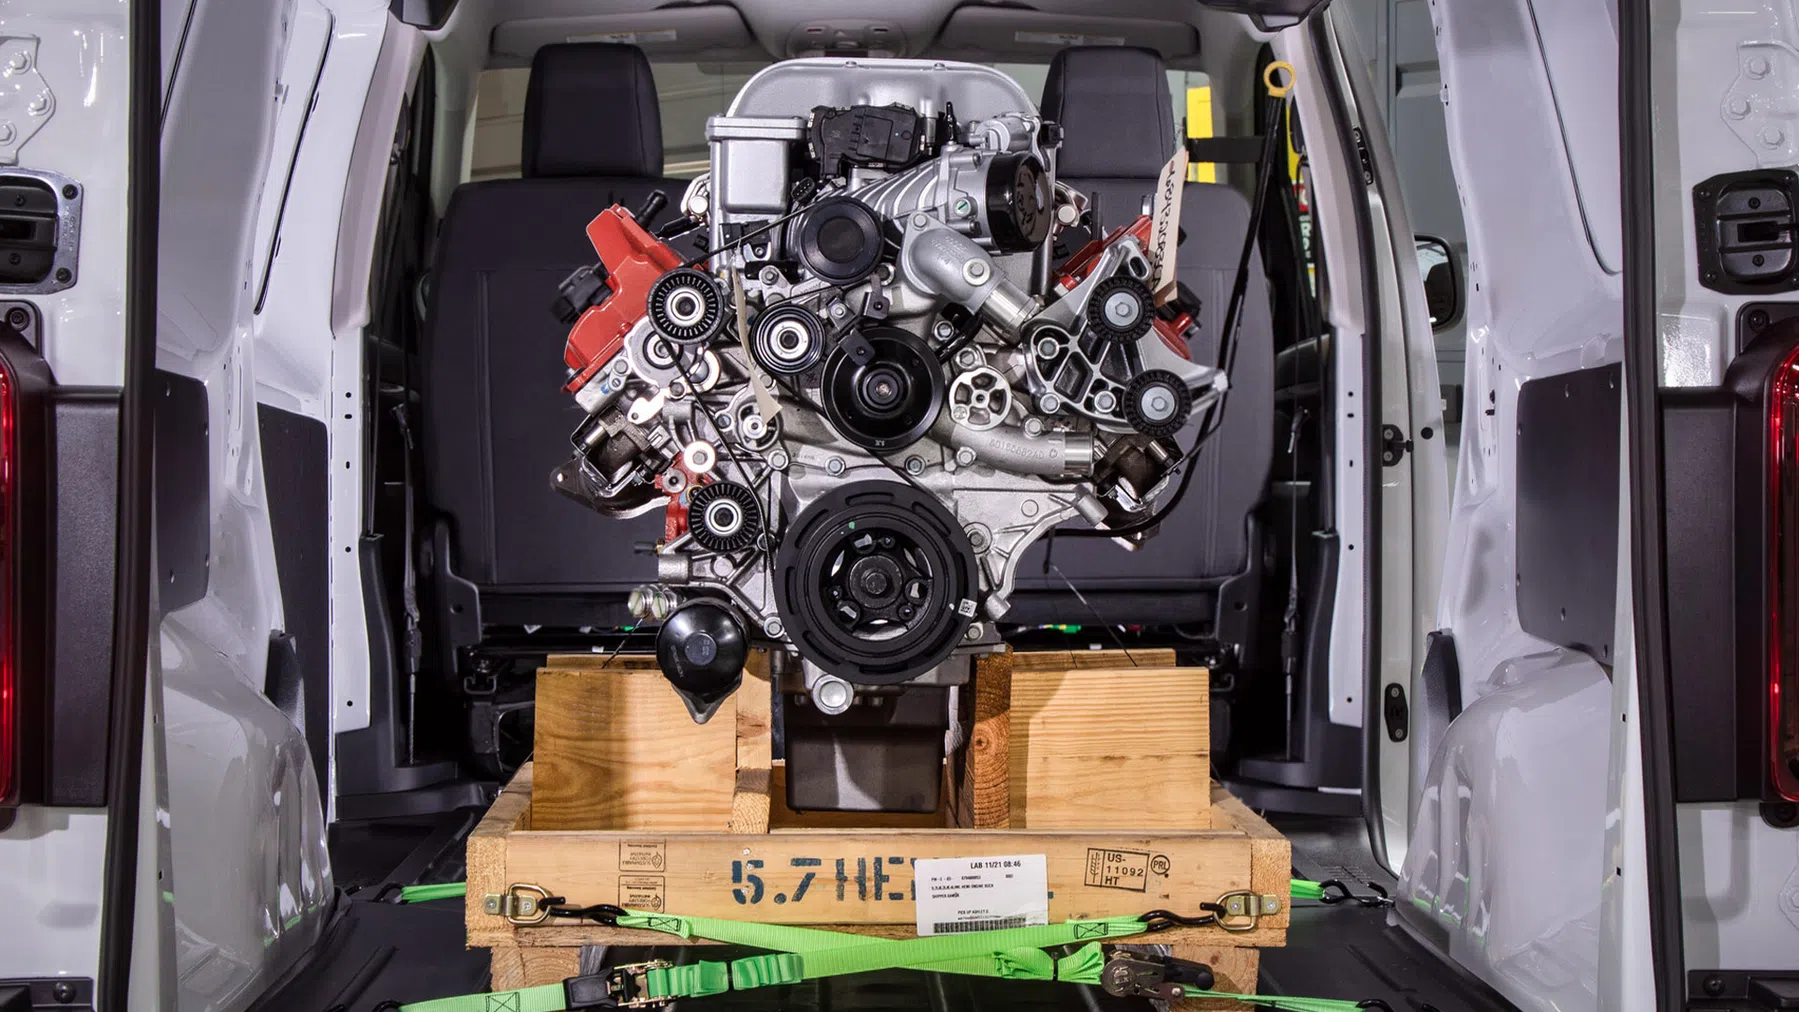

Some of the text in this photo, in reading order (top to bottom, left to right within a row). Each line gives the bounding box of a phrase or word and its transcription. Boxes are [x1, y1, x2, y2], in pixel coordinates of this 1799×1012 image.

[985, 861, 1002, 869] 11/21
[1107, 865, 1144, 877] 11092
[835, 856, 916, 902] HE
[1104, 875, 1120, 886] HT
